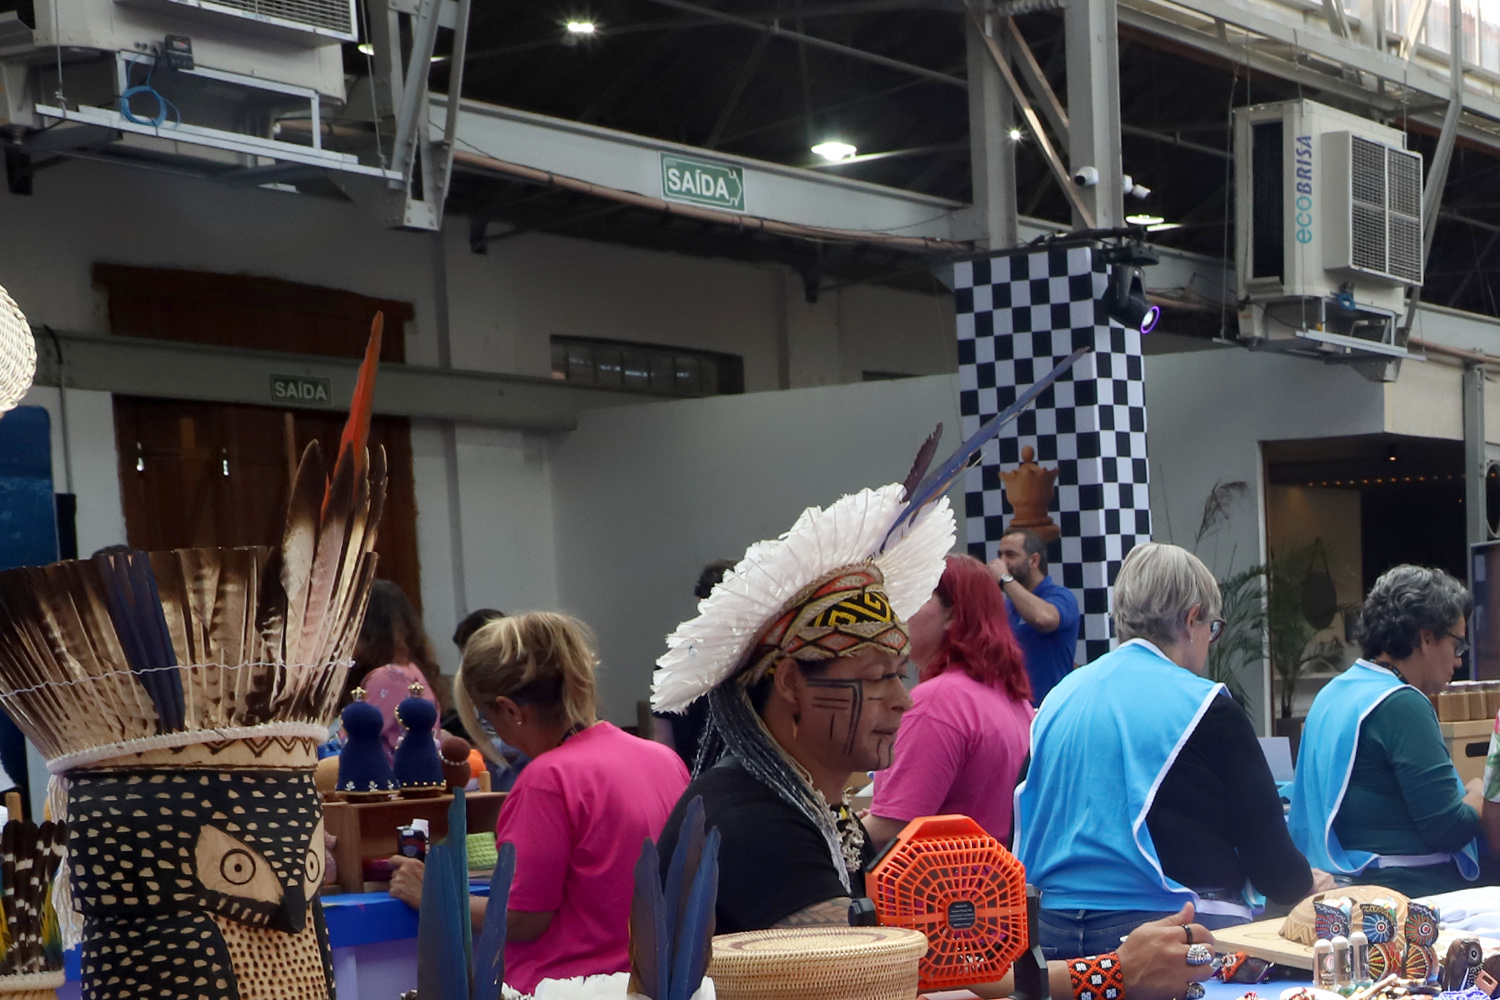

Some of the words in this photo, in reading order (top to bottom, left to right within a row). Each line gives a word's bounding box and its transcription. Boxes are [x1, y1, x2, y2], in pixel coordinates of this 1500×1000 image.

[667, 168, 729, 200] SAÍDA
[1296, 135, 1312, 244] ecoBRISA
[275, 381, 327, 400] SAÍDA
